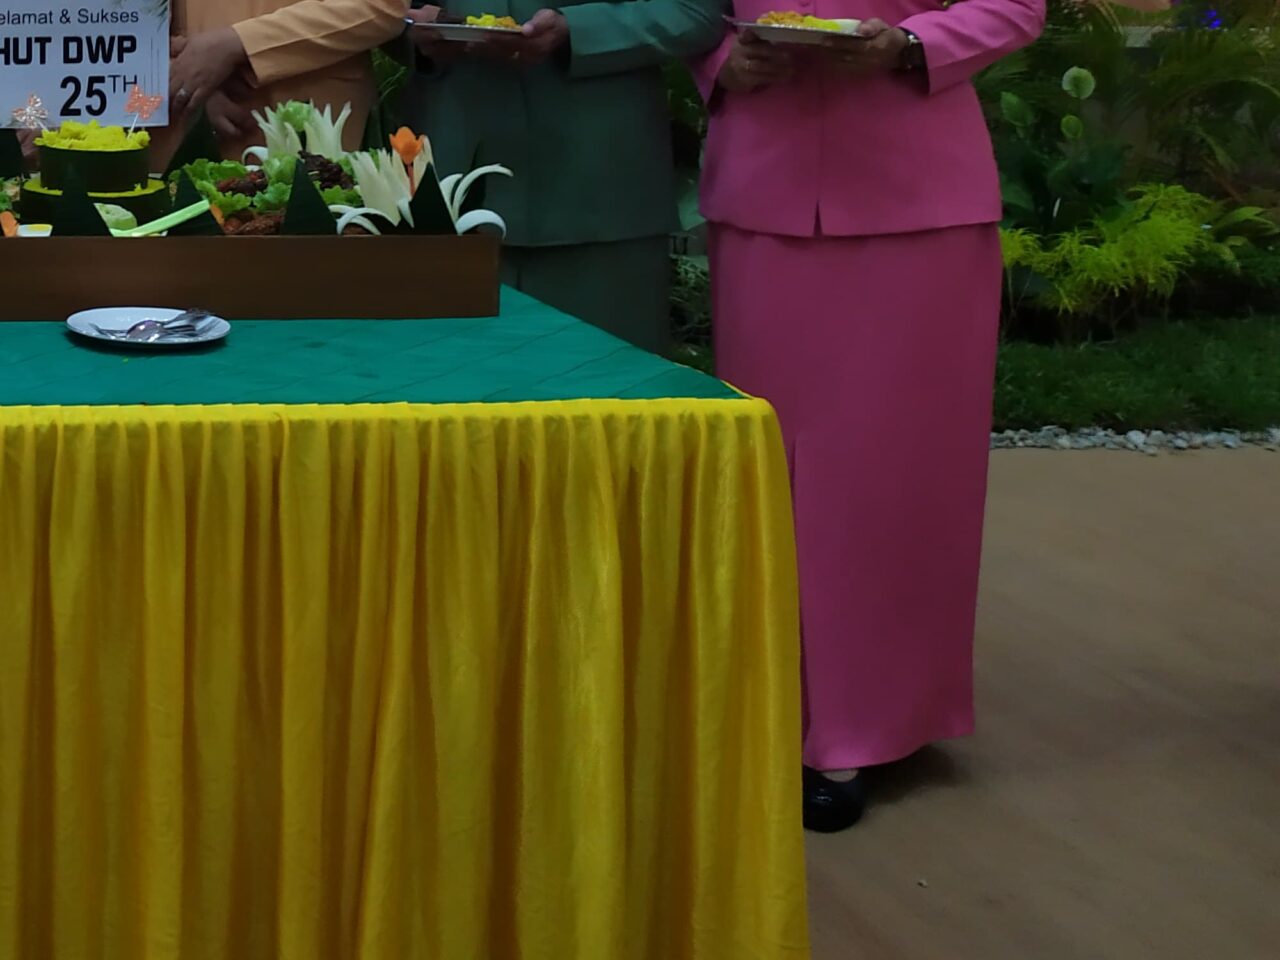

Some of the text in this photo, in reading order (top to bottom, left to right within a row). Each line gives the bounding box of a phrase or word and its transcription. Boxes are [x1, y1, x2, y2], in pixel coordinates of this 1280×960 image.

[59, 8, 71, 24] &
[77, 8, 140, 24] Sukses
[62, 34, 138, 65] DWP
